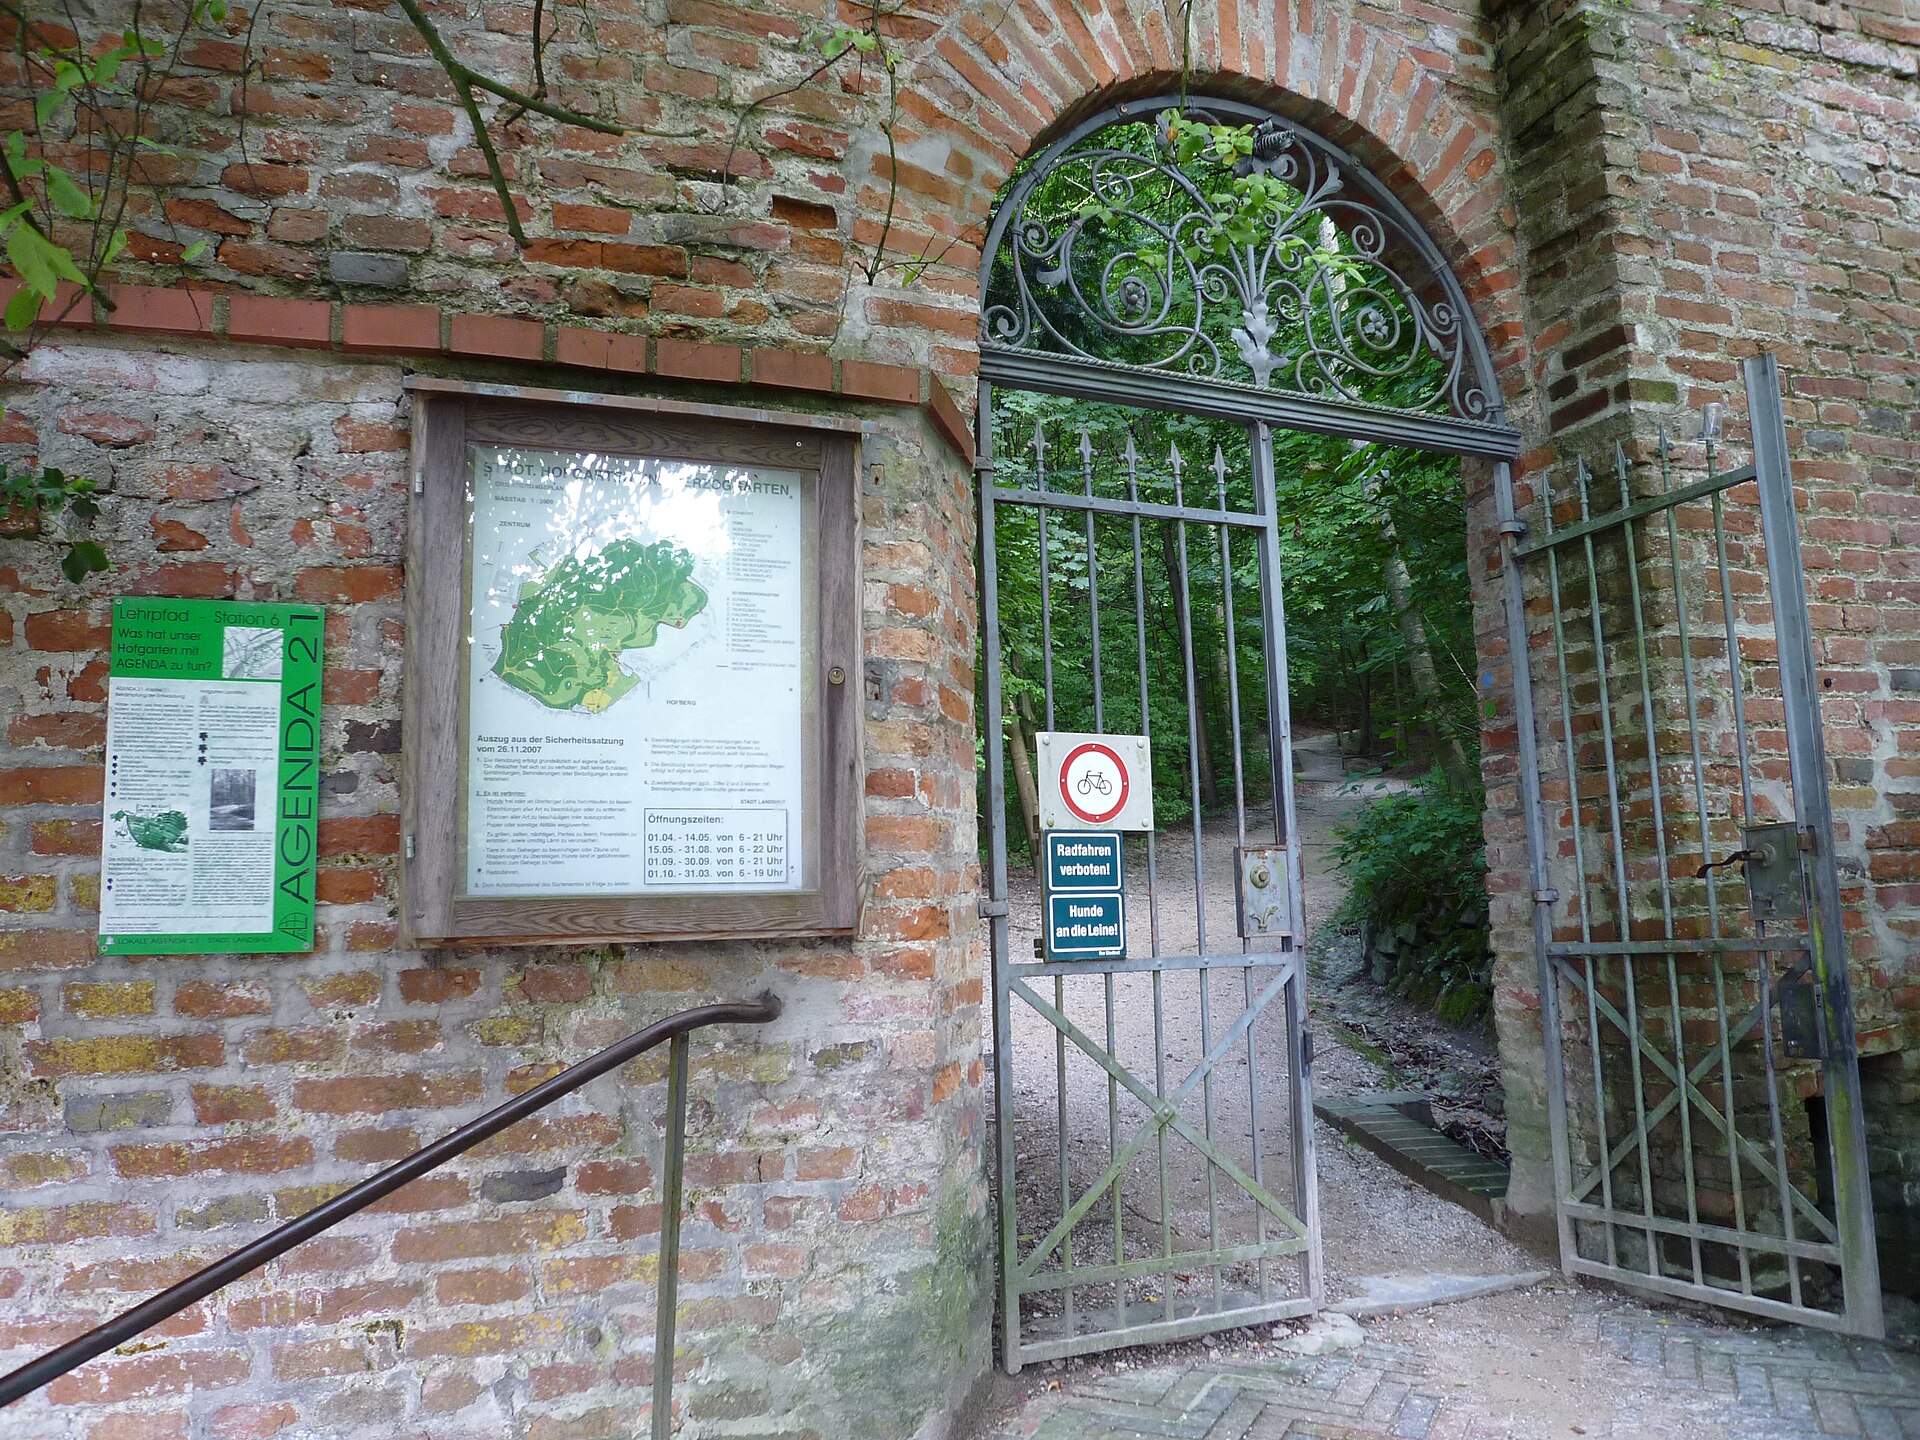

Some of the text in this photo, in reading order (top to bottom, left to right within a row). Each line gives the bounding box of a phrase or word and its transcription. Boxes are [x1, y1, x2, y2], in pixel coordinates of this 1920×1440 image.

[495, 495, 526, 503] MASSTAB
[119, 608, 189, 626] Lehrpfad
[214, 610, 265, 626] Station
[270, 613, 279, 626] 6
[118, 628, 202, 640] Was hat unser
[118, 643, 199, 657] Hofgarten mit
[117, 658, 212, 672] AGENDA zu tun?
[477, 735, 509, 744] Auszug
[545, 736, 624, 746] Sicherheitssatzung
[280, 614, 318, 904] AGENDA 21
[648, 813, 724, 825] Öffnungszeiten:
[648, 833, 676, 841] 01.04.
[685, 833, 712, 841] 14.05.
[648, 845, 676, 853] 15.05.
[685, 845, 712, 853] 31.08.
[1057, 843, 1111, 857] Radfahren
[648, 858, 676, 866] 01.09.
[685, 858, 712, 866] 30.09.
[648, 869, 676, 877] 01.10.
[685, 869, 712, 877] 31.03.
[1060, 863, 1110, 876] verboten!
[1070, 904, 1103, 918] Hunde
[1056, 923, 1118, 937] an die Leine!
